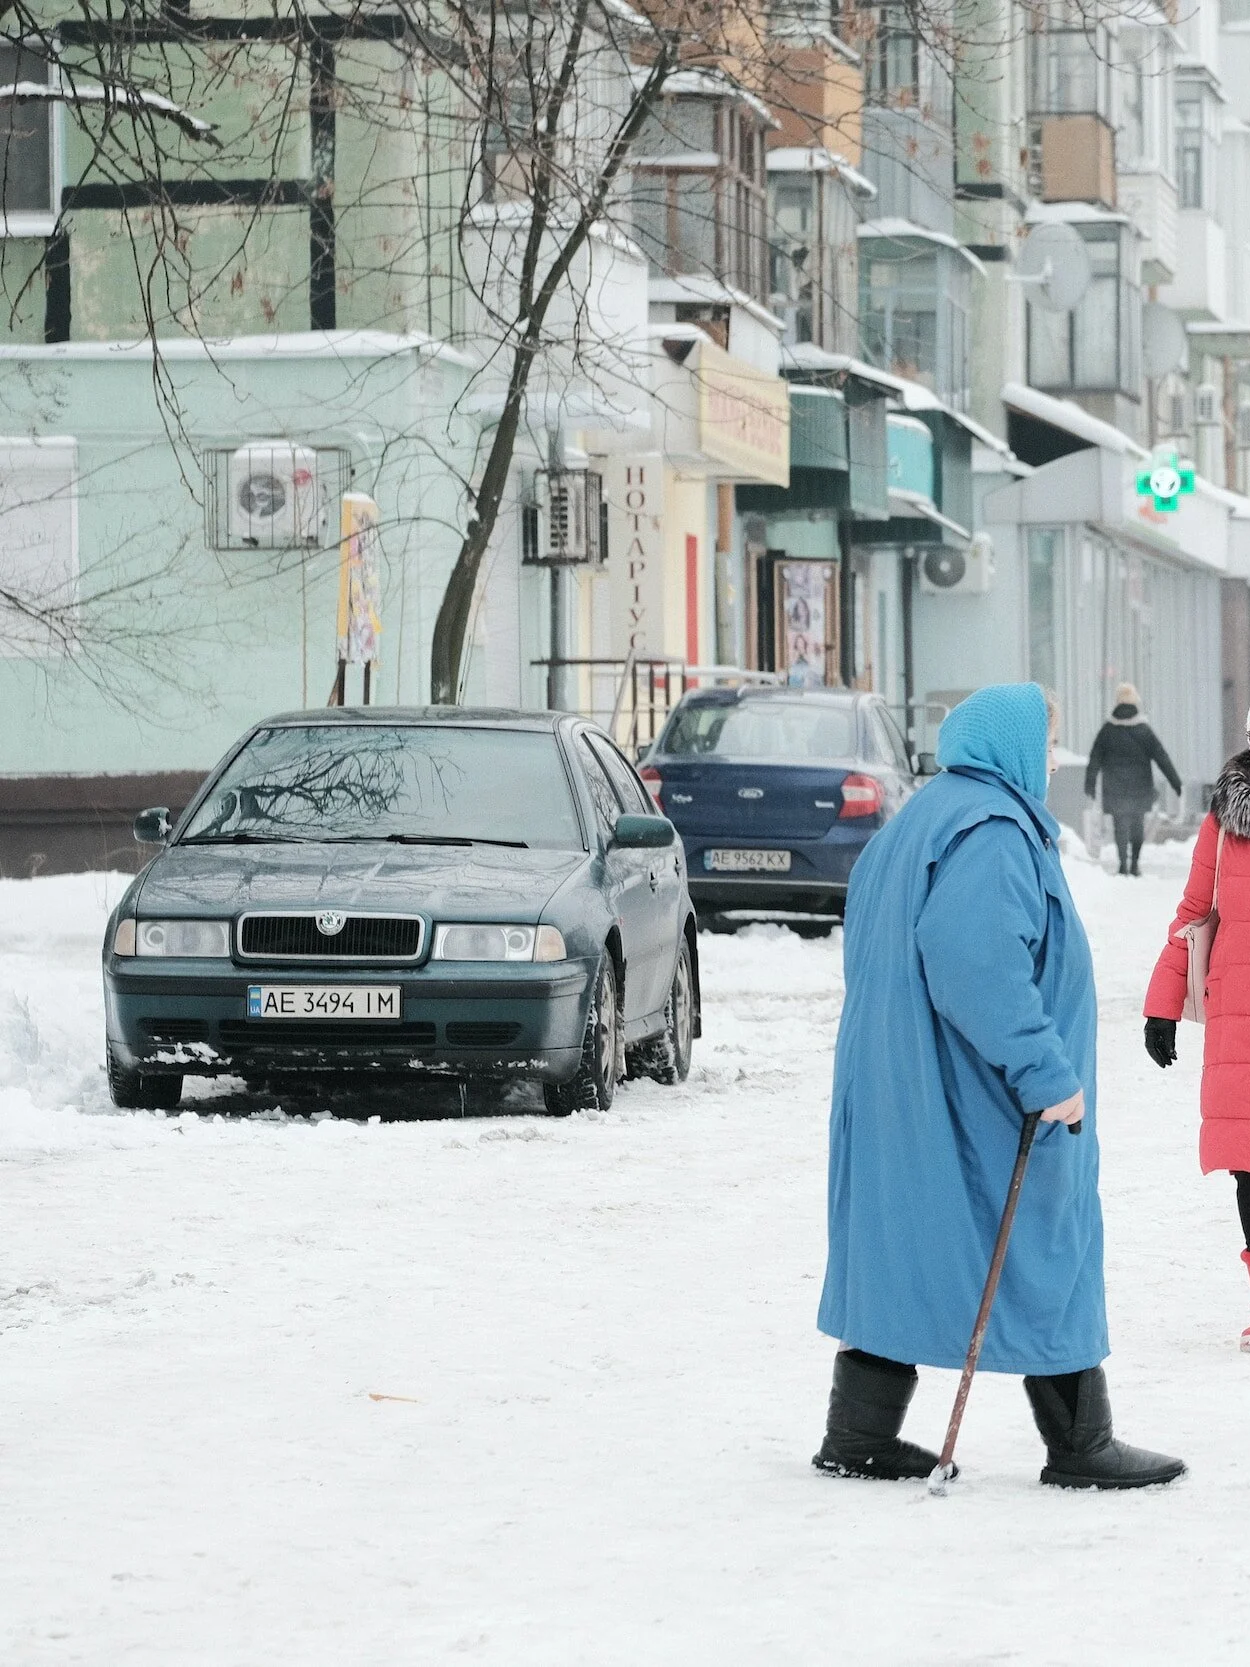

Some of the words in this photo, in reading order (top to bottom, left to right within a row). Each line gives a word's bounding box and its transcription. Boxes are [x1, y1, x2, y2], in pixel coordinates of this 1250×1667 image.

[625, 466, 646, 650] НОТАРІУС
[711, 854, 730, 864] AE
[734, 854, 765, 865] 9562
[767, 854, 787, 866] KX
[250, 1006, 261, 1014] UA
[264, 992, 296, 1013] AE
[303, 992, 354, 1013] 3494
